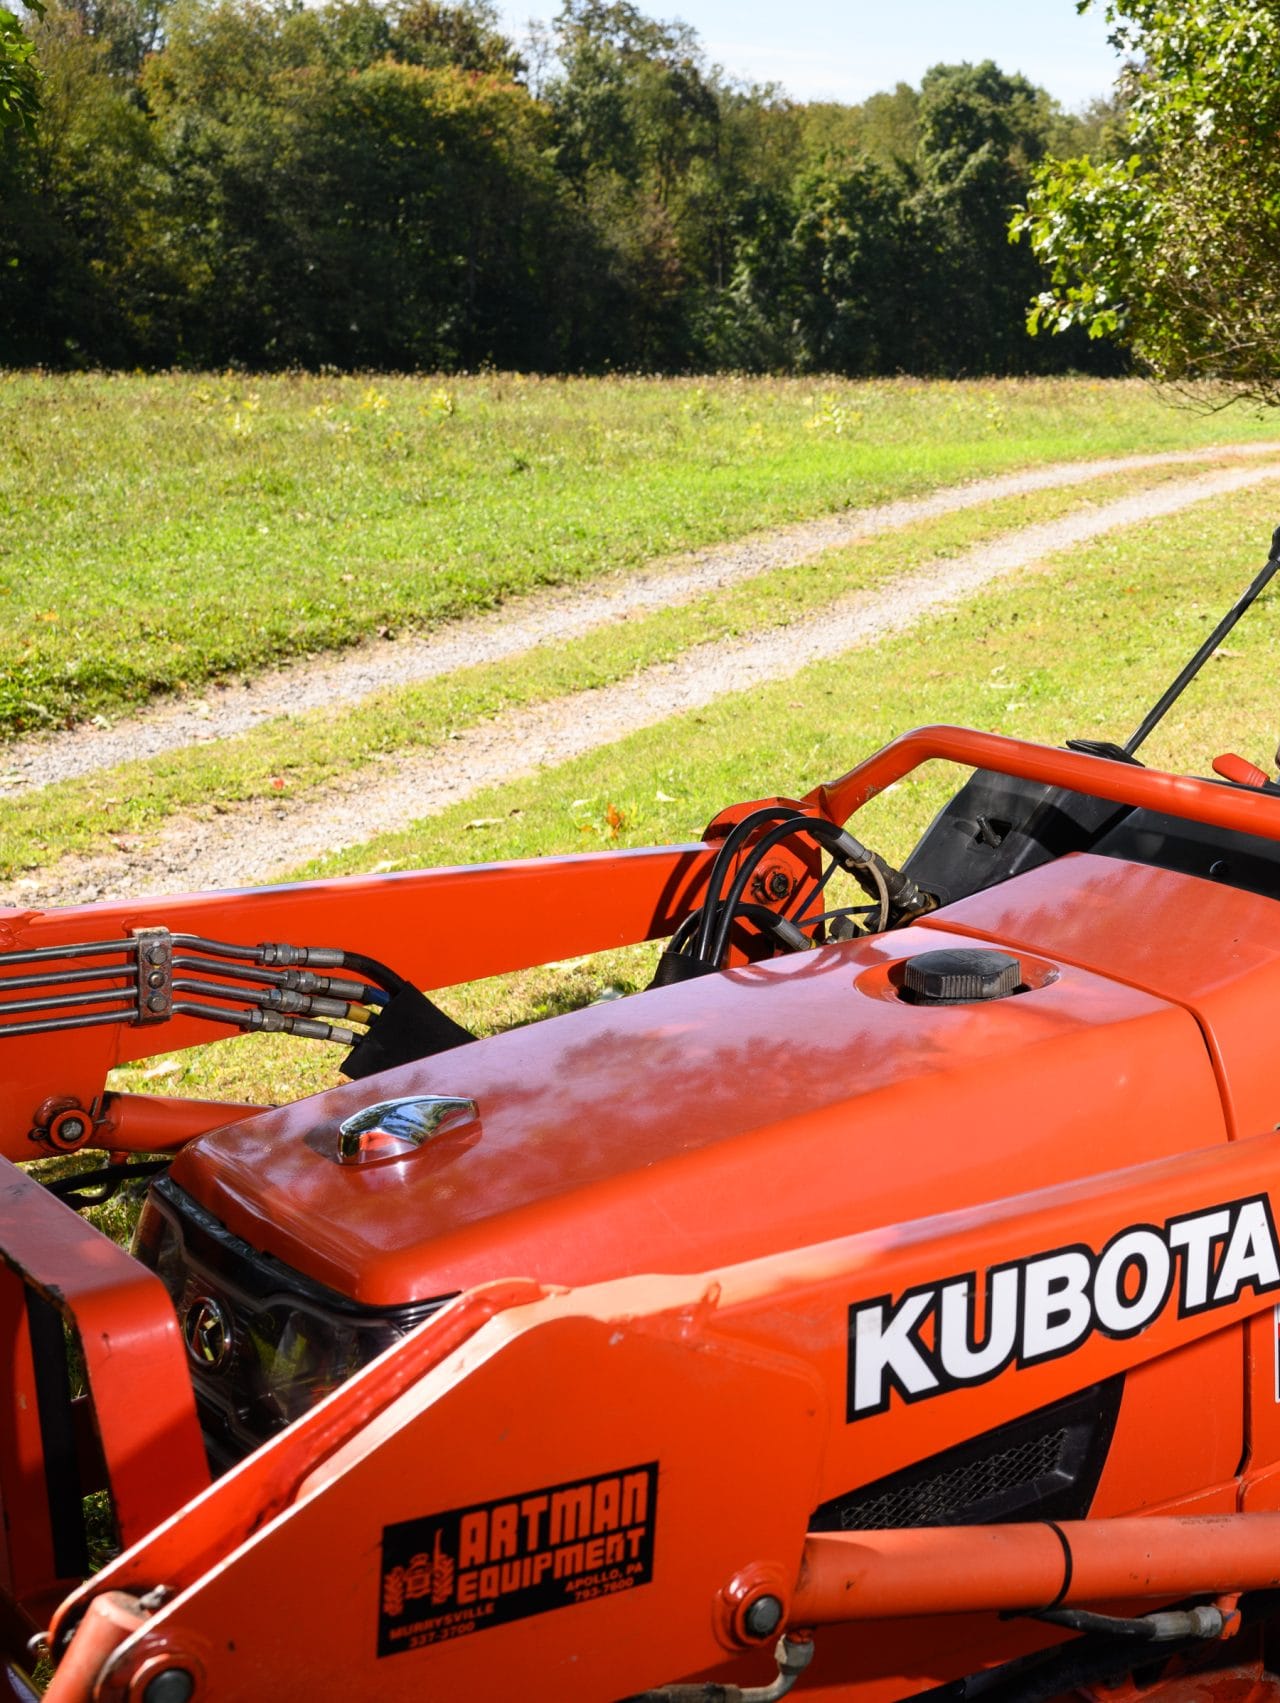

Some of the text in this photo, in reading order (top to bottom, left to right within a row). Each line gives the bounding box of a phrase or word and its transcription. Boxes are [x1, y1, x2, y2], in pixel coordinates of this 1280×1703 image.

[458, 1470, 650, 1570] ARTMAN
[456, 1526, 646, 1605] EQUIPMENT
[626, 1561, 644, 1575] PA
[389, 1601, 495, 1642] MURRYSVILLE
